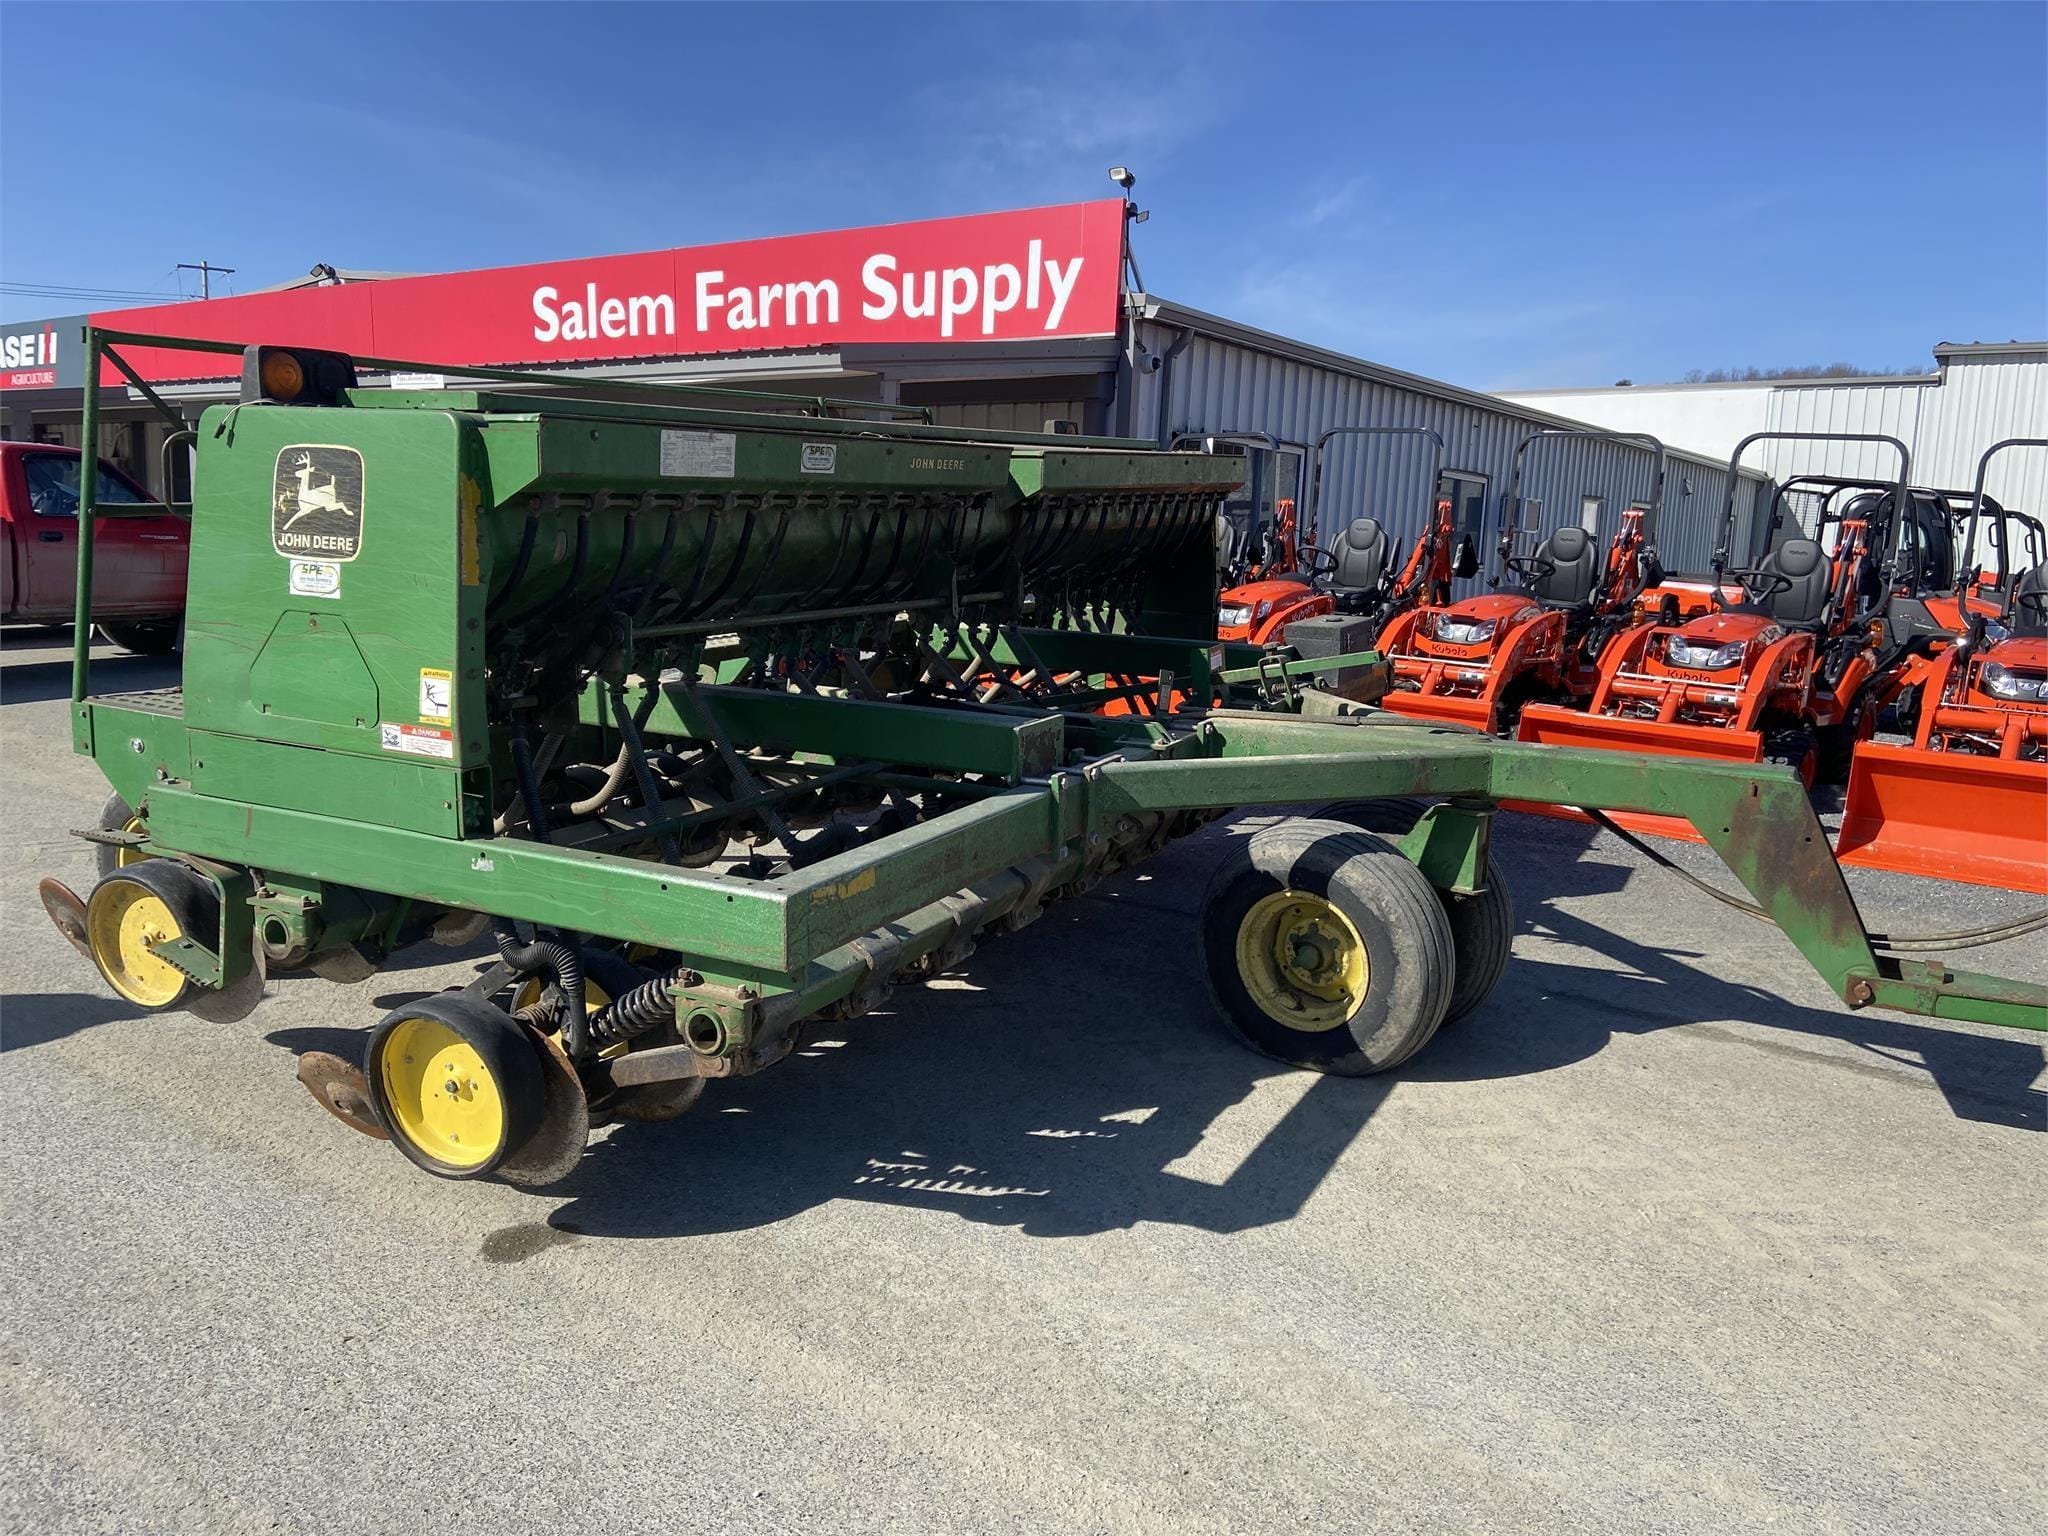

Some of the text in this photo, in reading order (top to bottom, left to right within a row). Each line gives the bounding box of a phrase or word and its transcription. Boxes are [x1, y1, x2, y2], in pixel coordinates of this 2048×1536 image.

[532, 239, 1085, 343] Salem Farm Supply
[910, 458, 965, 471] JOHN DEERE
[278, 533, 354, 552] JOHN DEERE
[1431, 644, 1468, 657] Kubota
[1667, 668, 1712, 683] Kubota
[417, 728, 441, 738] DANGER
